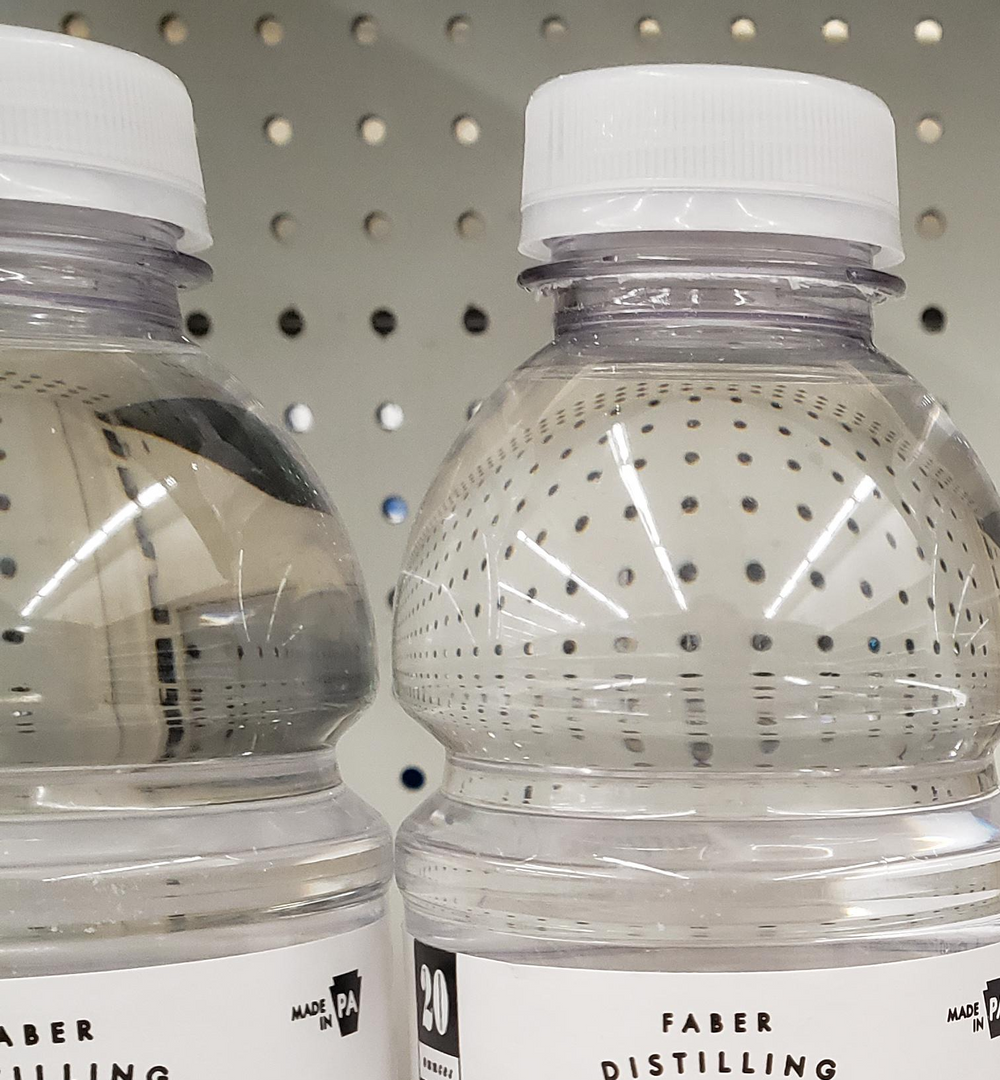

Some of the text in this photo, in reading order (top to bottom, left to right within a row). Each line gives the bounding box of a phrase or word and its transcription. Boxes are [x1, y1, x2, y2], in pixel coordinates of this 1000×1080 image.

[291, 998, 326, 1021] MADE
[337, 993, 358, 1018] PA
[420, 963, 449, 1036] 20
[320, 1014, 332, 1031] IN
[662, 1013, 772, 1033] FABER
[947, 1002, 979, 1022] MADE
[973, 1017, 984, 1032] IN
[422, 1057, 454, 1079] ounces
[601, 1051, 837, 1080] DISTILLING
